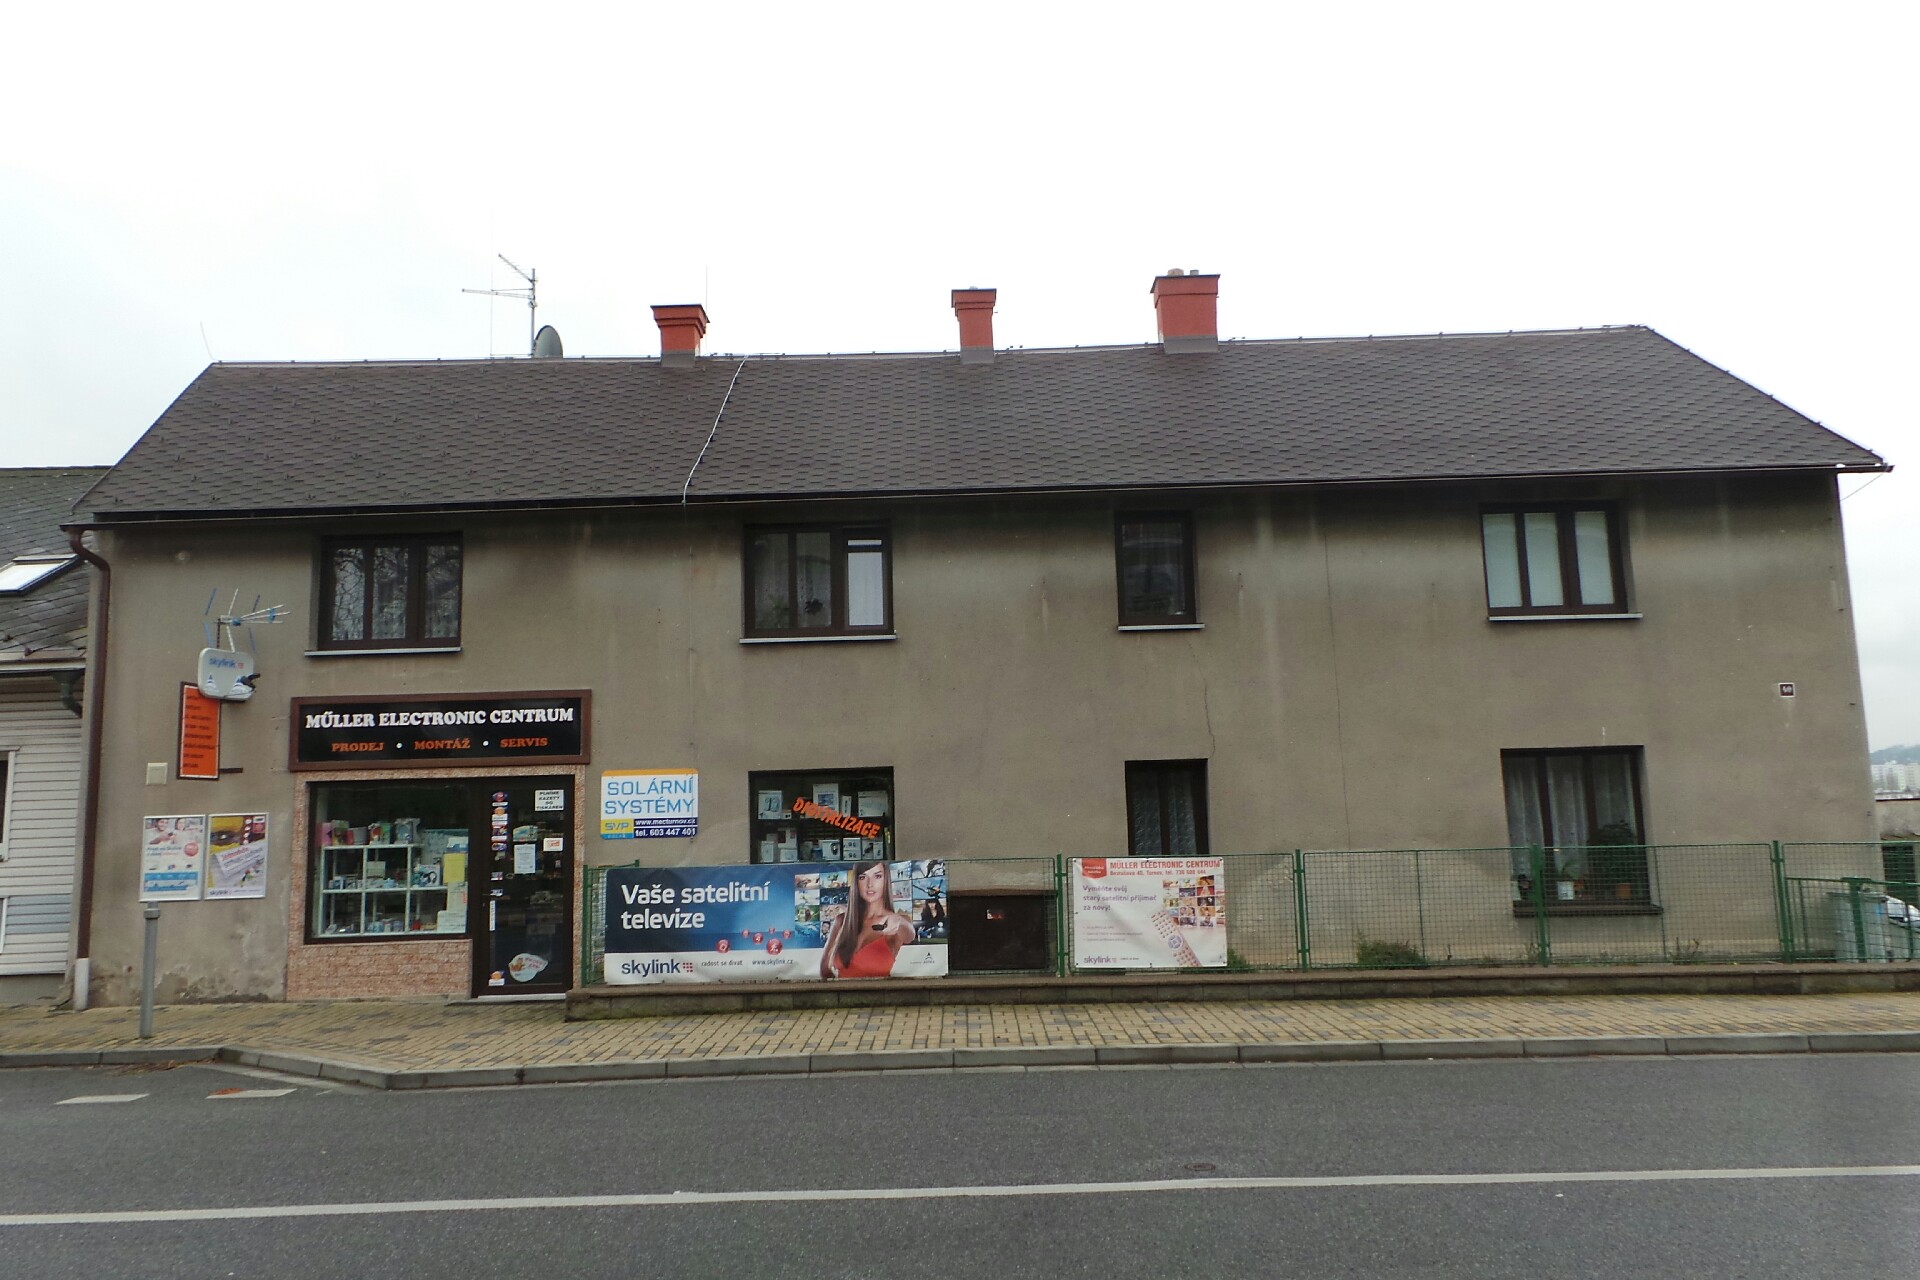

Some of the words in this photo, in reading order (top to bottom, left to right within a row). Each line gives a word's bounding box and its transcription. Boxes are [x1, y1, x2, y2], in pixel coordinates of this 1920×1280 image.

[379, 710, 487, 727] ELECTRONIC
[489, 708, 574, 724] CENTRUM
[331, 742, 385, 752] PRODEJ
[414, 737, 471, 750] MONTÁŽ
[499, 737, 548, 748] SERVIS
[607, 776, 693, 796] SOLÁRNÍ
[604, 796, 695, 815] SYSTÉMY
[792, 796, 881, 839] DIGITALIZACE
[665, 828, 680, 836] 447
[1140, 861, 1184, 869] ELECTRONIC
[1185, 860, 1220, 868] CENTRUM
[620, 883, 675, 905] Vaše
[680, 881, 771, 904] satelitní
[620, 908, 705, 930] televize
[621, 959, 681, 977] skylink
[752, 958, 793, 966] www.skylink.cz
[1083, 955, 1111, 965] skylink
